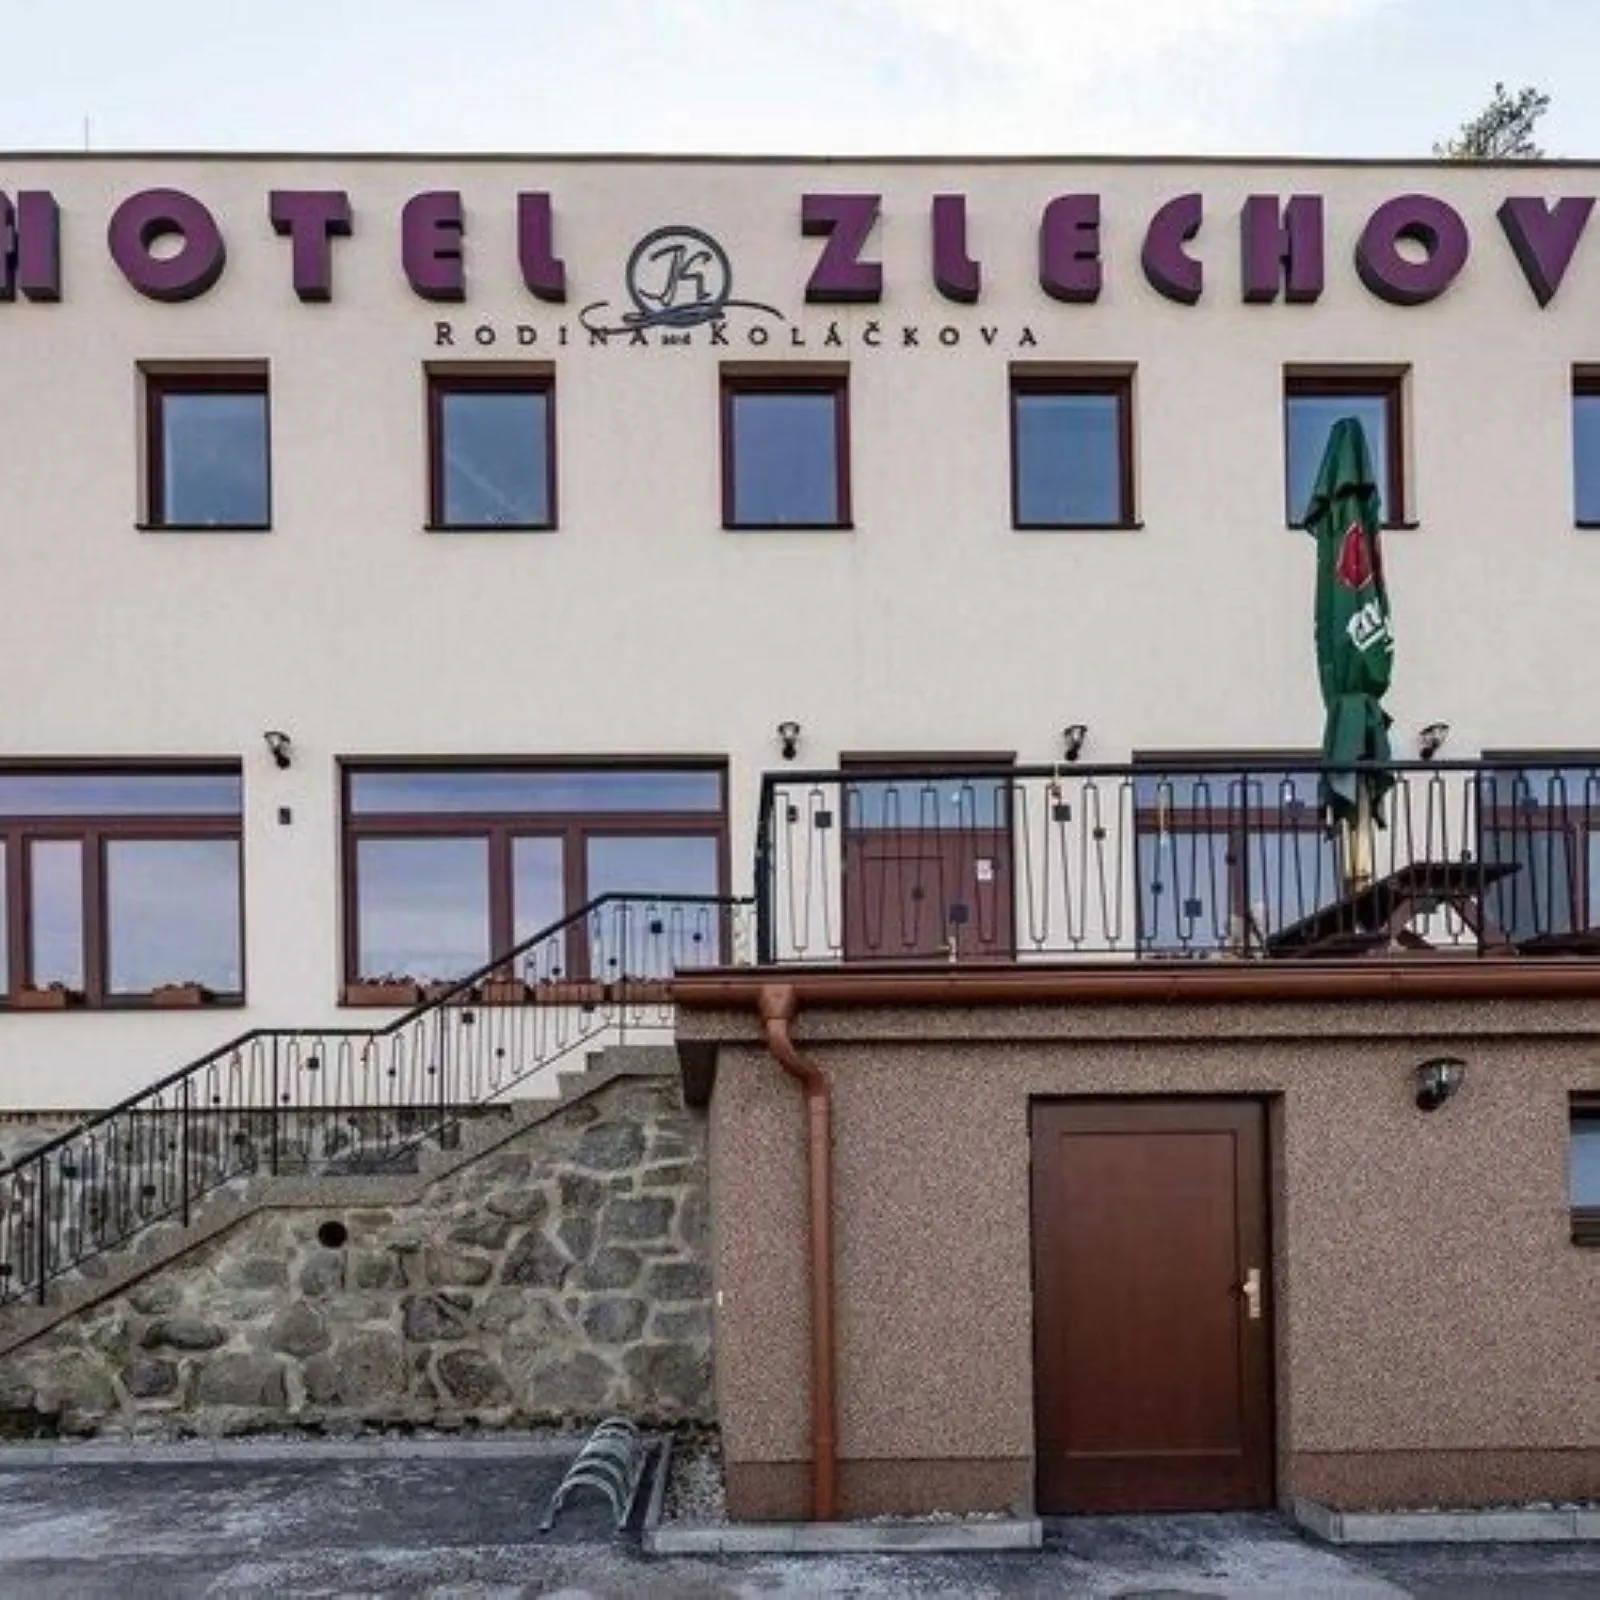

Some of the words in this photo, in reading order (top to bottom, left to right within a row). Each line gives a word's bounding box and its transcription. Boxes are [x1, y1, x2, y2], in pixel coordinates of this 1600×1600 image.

[0, 188, 567, 303] HOTEL
[800, 193, 1597, 308] ZLECHOV
[434, 321, 649, 347] RODINA
[709, 320, 1037, 347] KOLÁČKOVA
